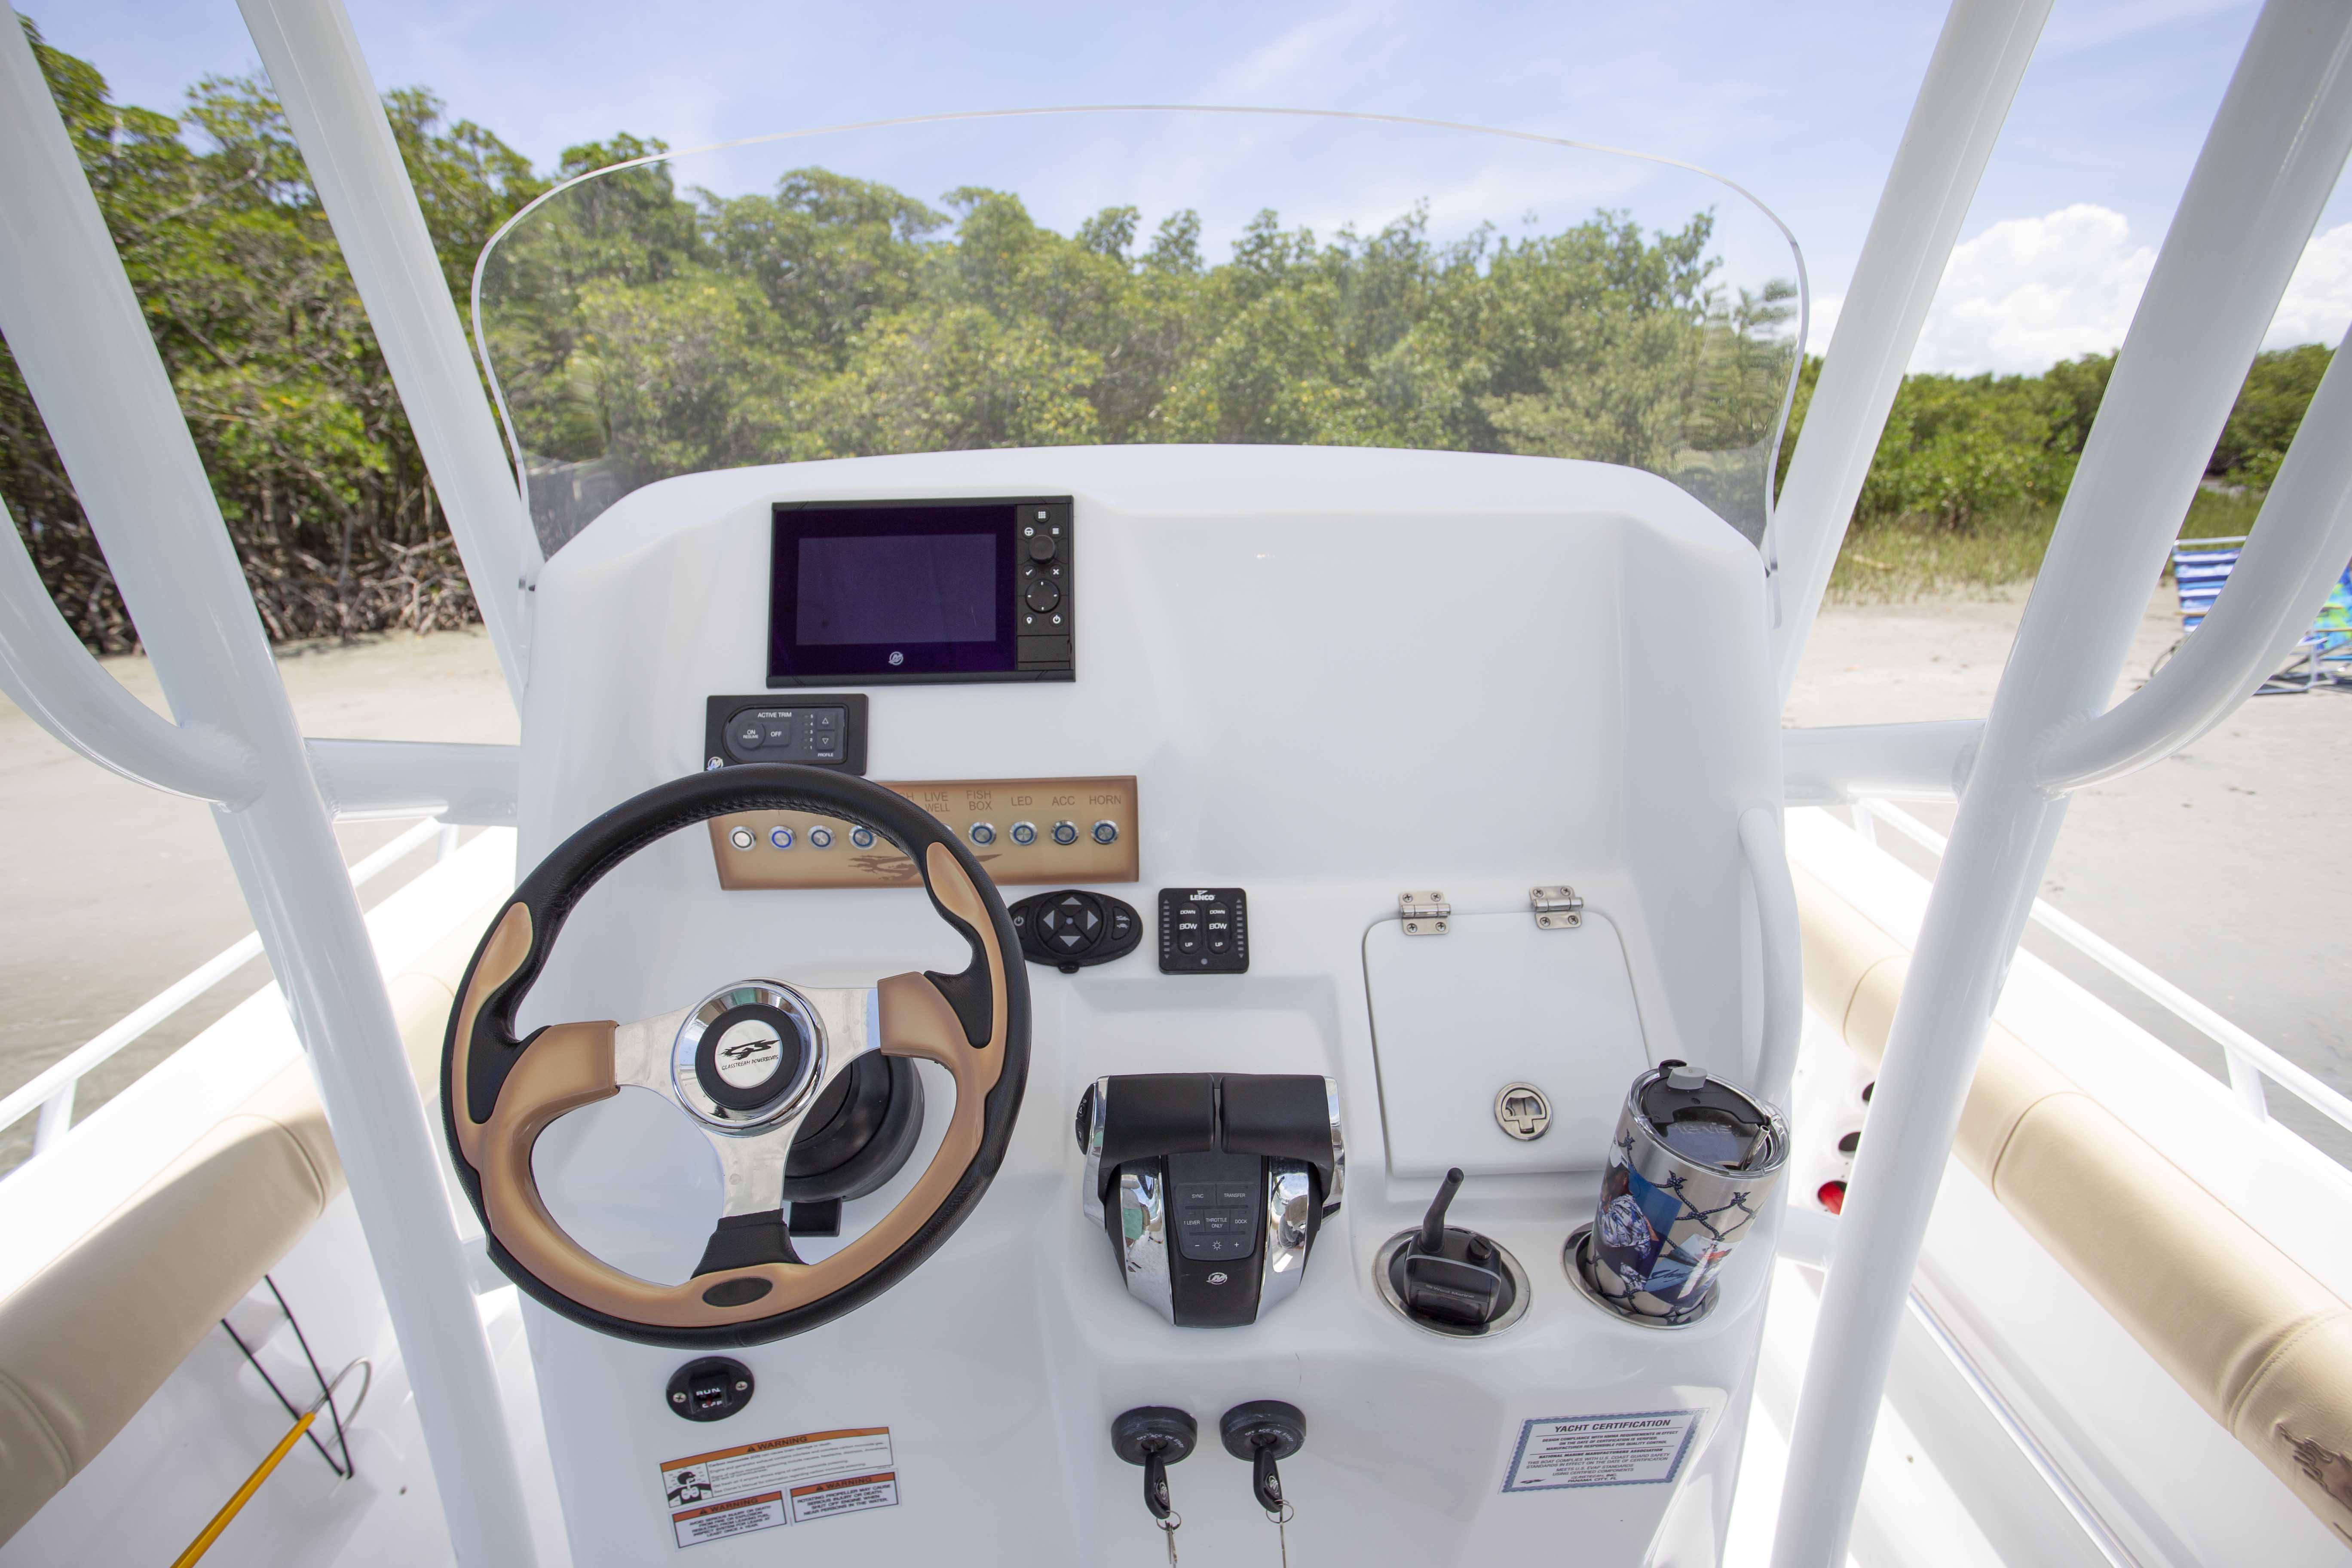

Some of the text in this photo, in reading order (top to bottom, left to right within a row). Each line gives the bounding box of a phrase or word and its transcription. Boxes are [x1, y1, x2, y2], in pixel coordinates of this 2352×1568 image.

[925, 791, 949, 802] LIVE
[966, 790, 992, 799] FISH
[1011, 796, 1032, 806] LED
[1051, 796, 1076, 806] ACC
[1089, 795, 1121, 805] HORN
[925, 802, 950, 812] WELL
[969, 801, 992, 811] BOX
[722, 1054, 779, 1070] GLASSTREAM POWERBOATS
[696, 1387, 721, 1396] RUN
[1592, 1420, 1671, 1430] CERTIFICATION
[757, 1436, 807, 1450] WARNING
[826, 1477, 872, 1489] WARNING
[797, 1494, 824, 1504] ROTATING
[826, 1489, 858, 1498] PROPELLER
[710, 1498, 758, 1512] WARNING
